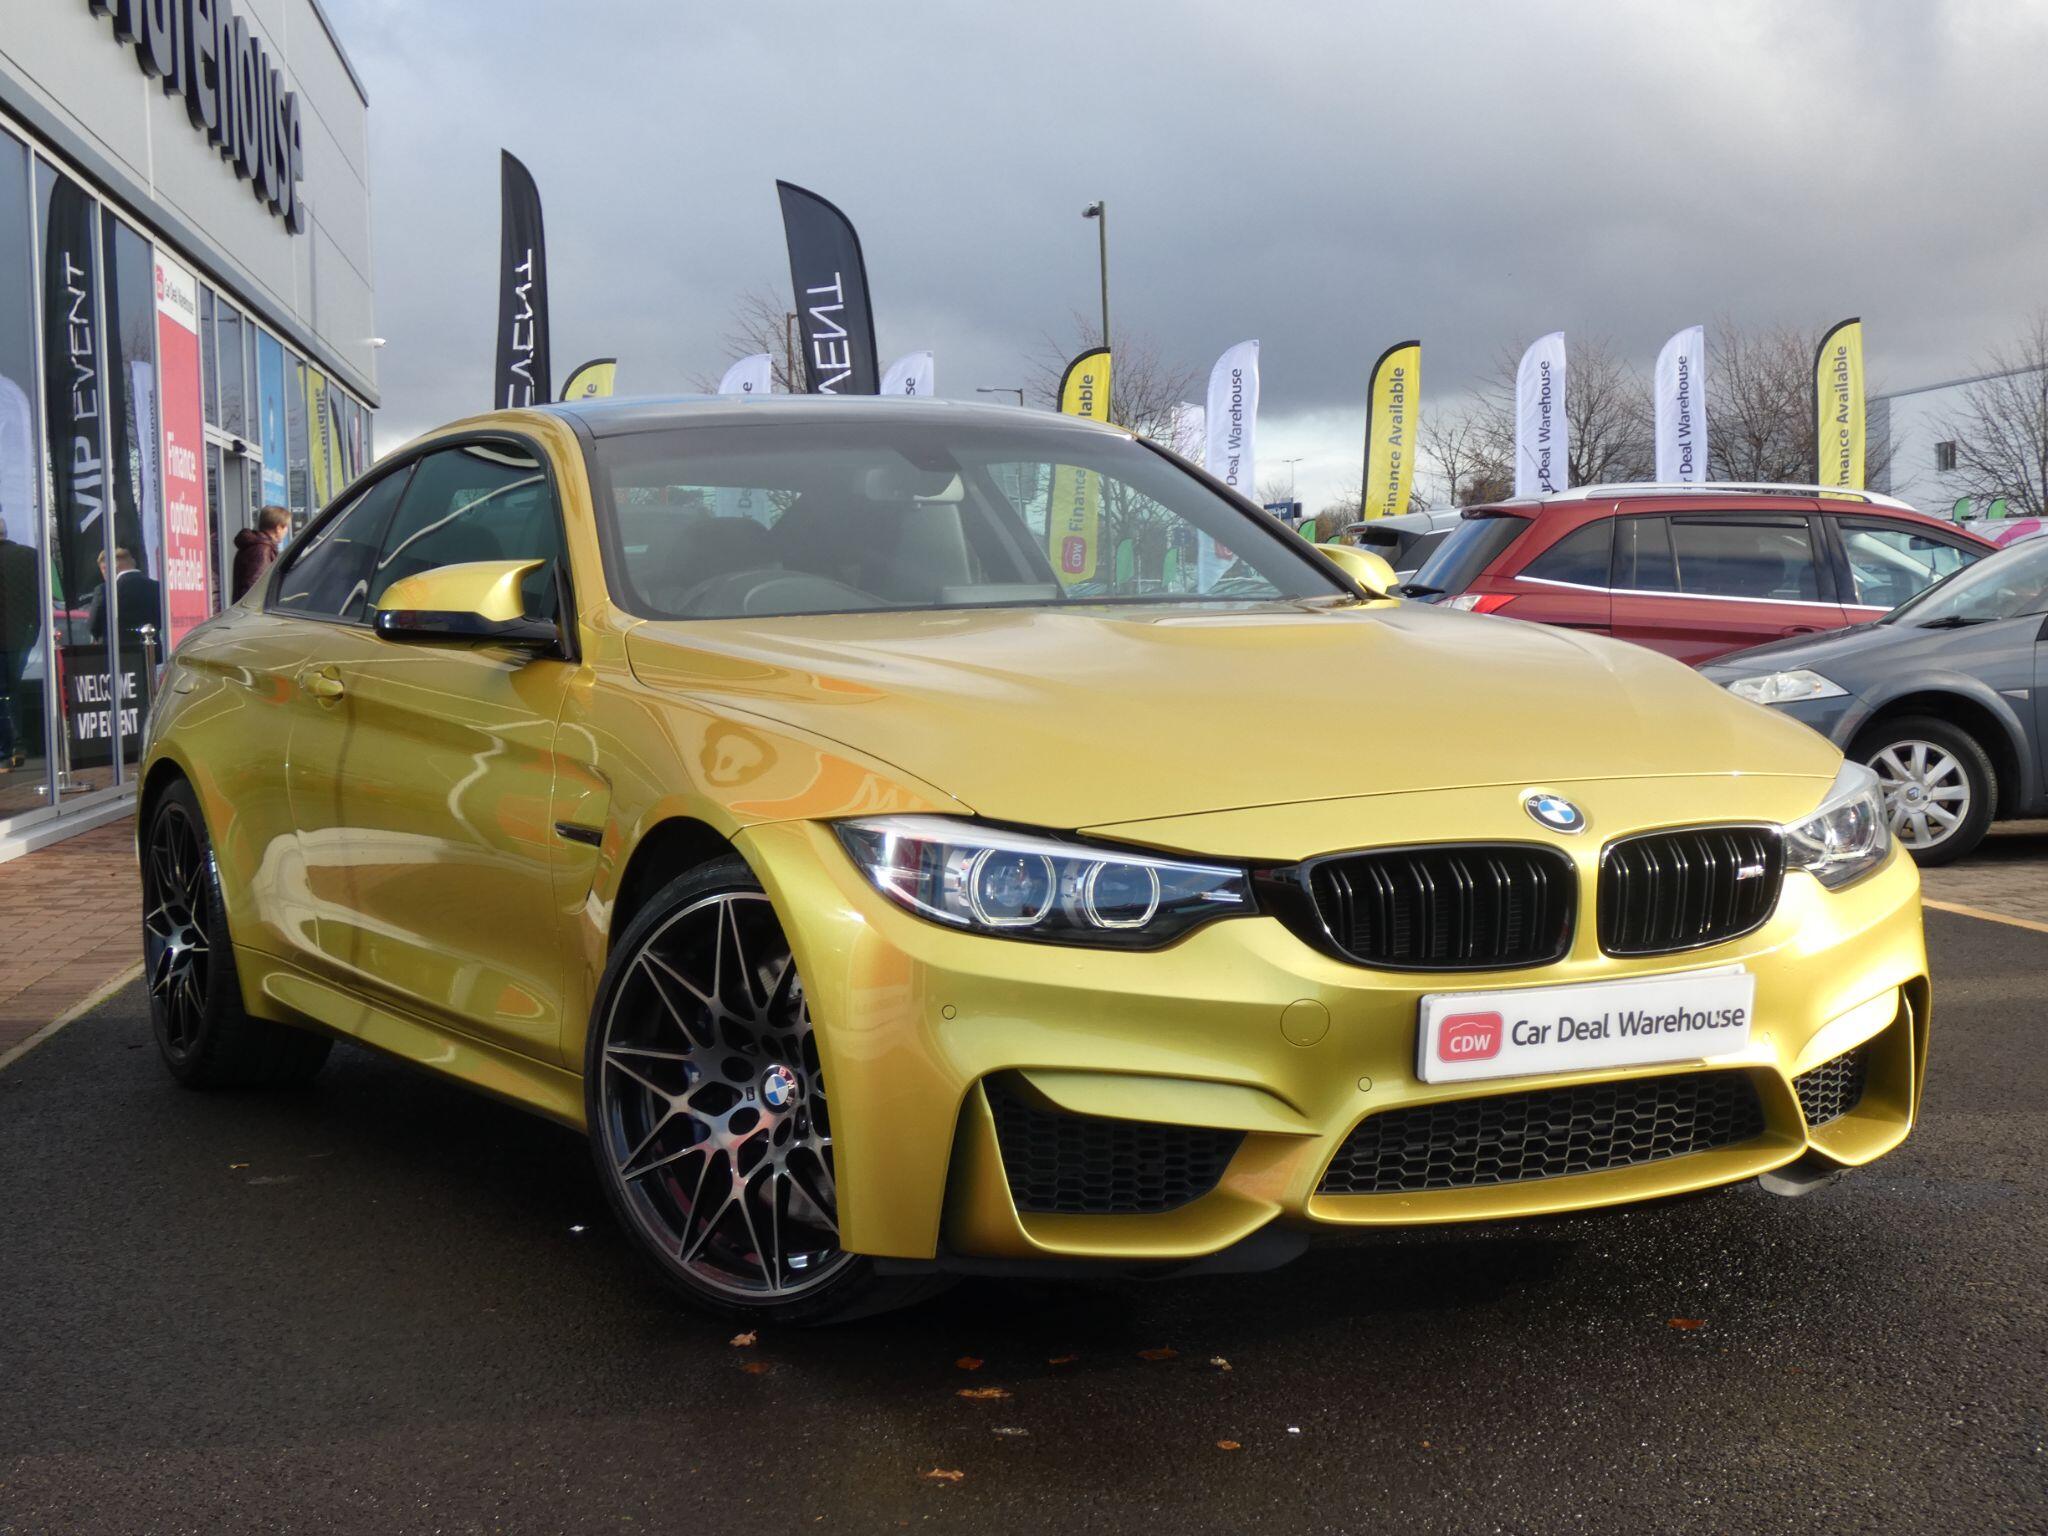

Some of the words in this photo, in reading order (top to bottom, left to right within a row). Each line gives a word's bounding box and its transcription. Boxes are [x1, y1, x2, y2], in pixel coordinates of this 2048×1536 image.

[88, 0, 304, 235] arehouse
[65, 251, 99, 421] EVENT
[1228, 368, 1242, 449] Warehouse
[1388, 367, 1405, 446] Available
[1538, 360, 1551, 443] Warehouse
[1677, 355, 1691, 439] Warehouse
[1834, 346, 1849, 424] Available
[73, 436, 116, 534] VIP
[167, 431, 196, 483] Finance
[1226, 454, 1240, 486] Deal
[1382, 451, 1402, 516] Finance
[1539, 448, 1550, 479] Deal
[1679, 441, 1693, 474] Deal
[1837, 429, 1849, 488] inance
[170, 491, 198, 547] options
[1069, 469, 1086, 532] Finance
[1072, 543, 1083, 567] CDW
[75, 672, 137, 702] WELCME
[78, 712, 97, 739] VIP
[1450, 1034, 1491, 1053] CDW
[1512, 1020, 1551, 1046] Car
[1557, 1013, 1610, 1043] Deal
[1618, 1007, 1745, 1037] Warehouse
